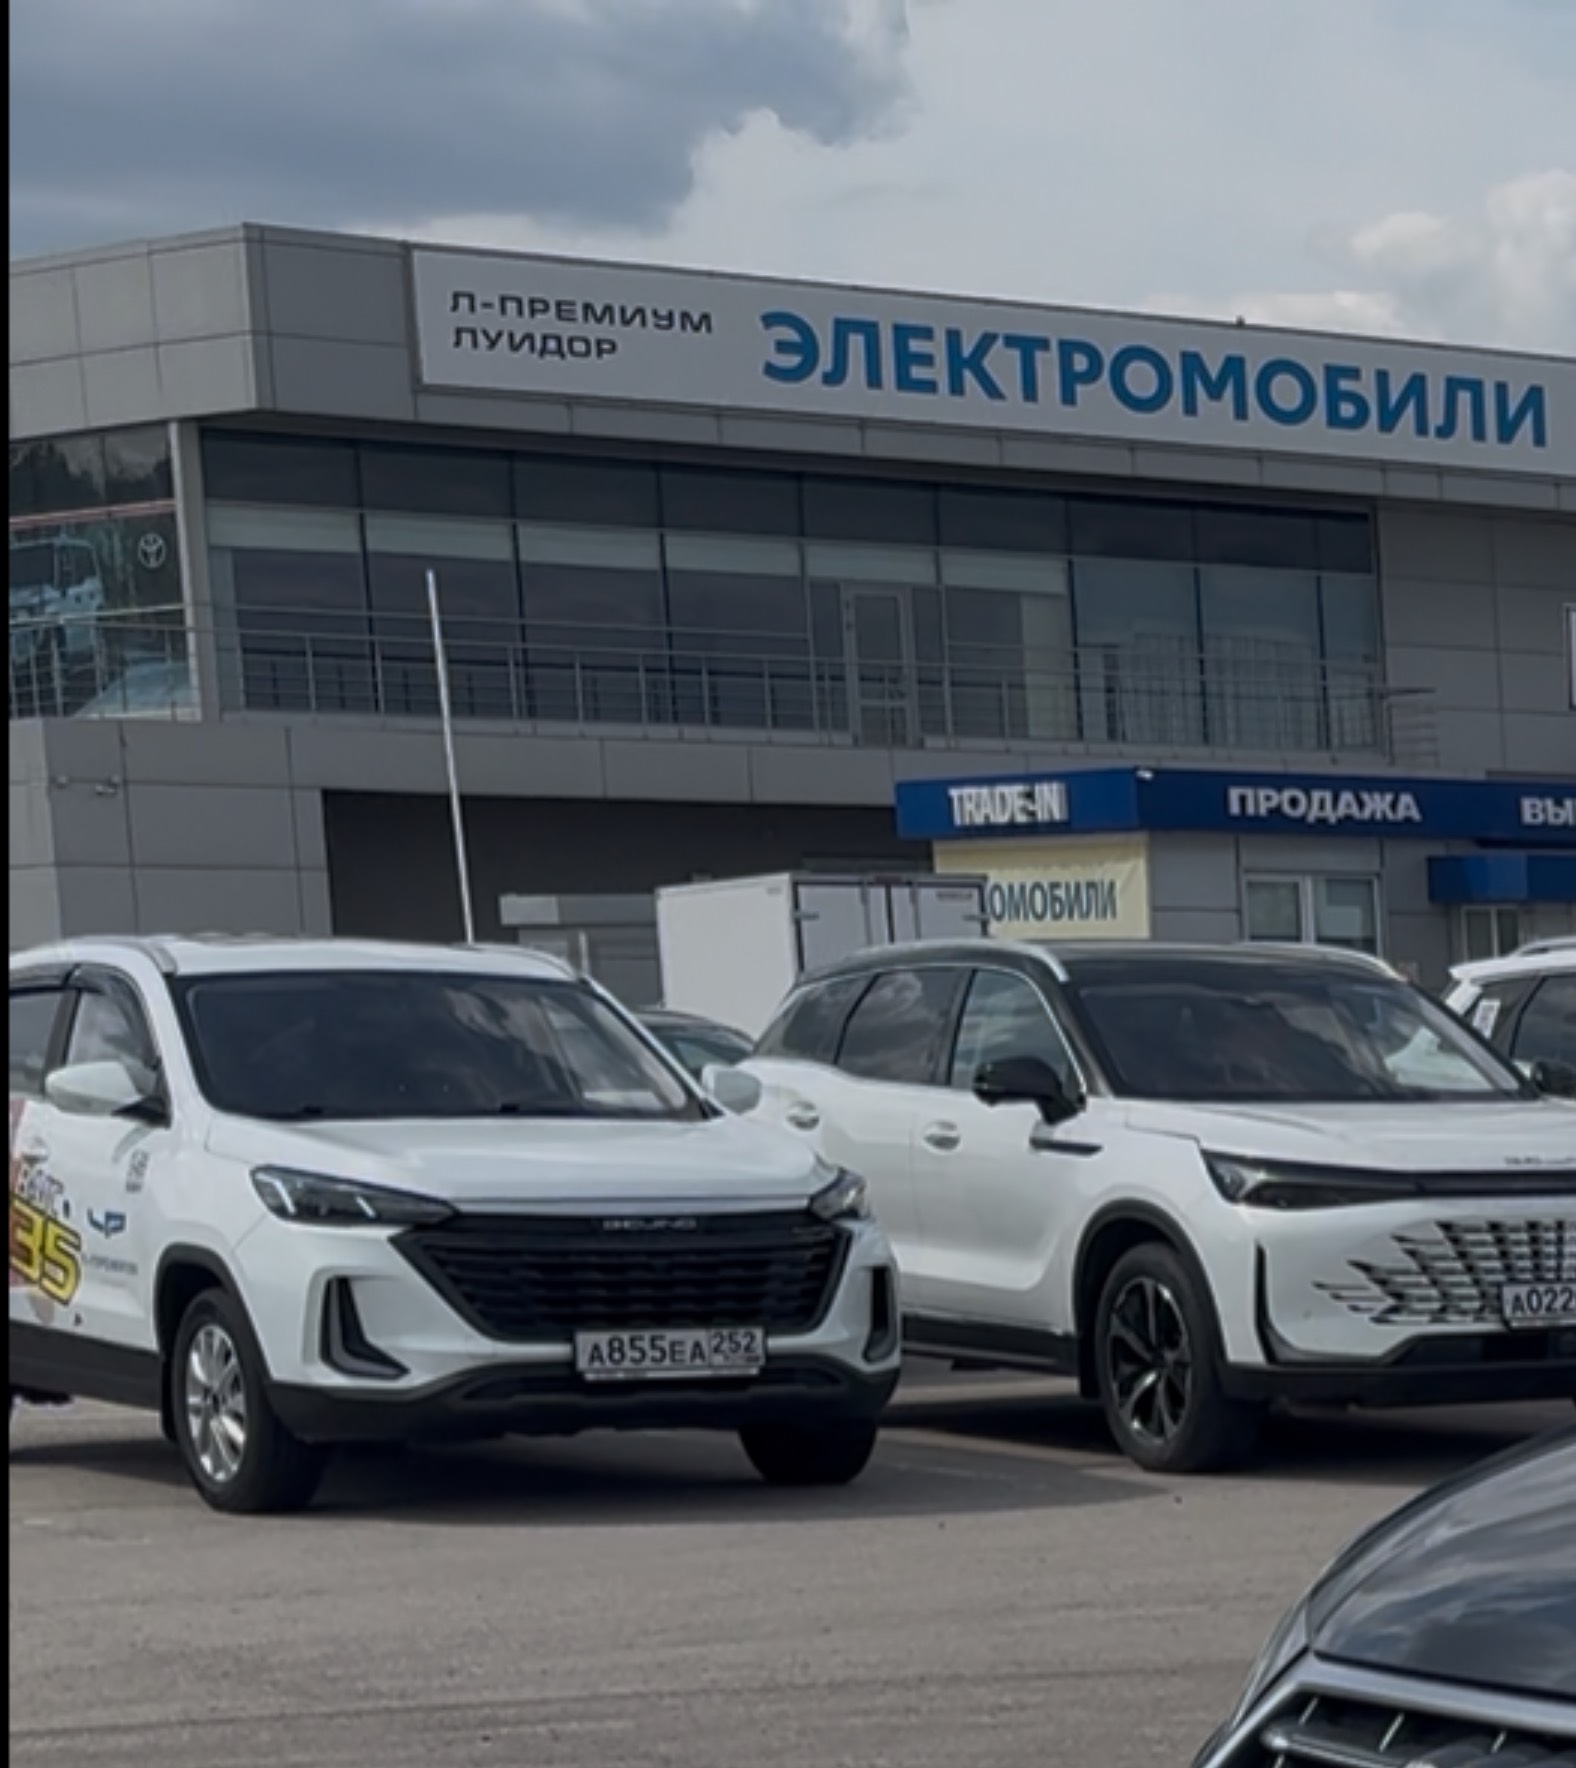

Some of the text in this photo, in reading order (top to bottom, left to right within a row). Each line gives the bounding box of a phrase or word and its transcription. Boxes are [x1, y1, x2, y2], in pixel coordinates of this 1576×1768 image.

[450, 290, 713, 334] Л-ПРЕМИУМ
[453, 326, 618, 360] ЛУИДОР
[759, 310, 1547, 449] ЭЛЕКТРОМОБИЛИ
[948, 781, 1069, 827] TRADE-IN
[1228, 786, 1421, 824] ПРОДАЖА
[989, 879, 1118, 922] ОМОБИЛИ
[588, 1331, 757, 1366] А855ЕА 252
